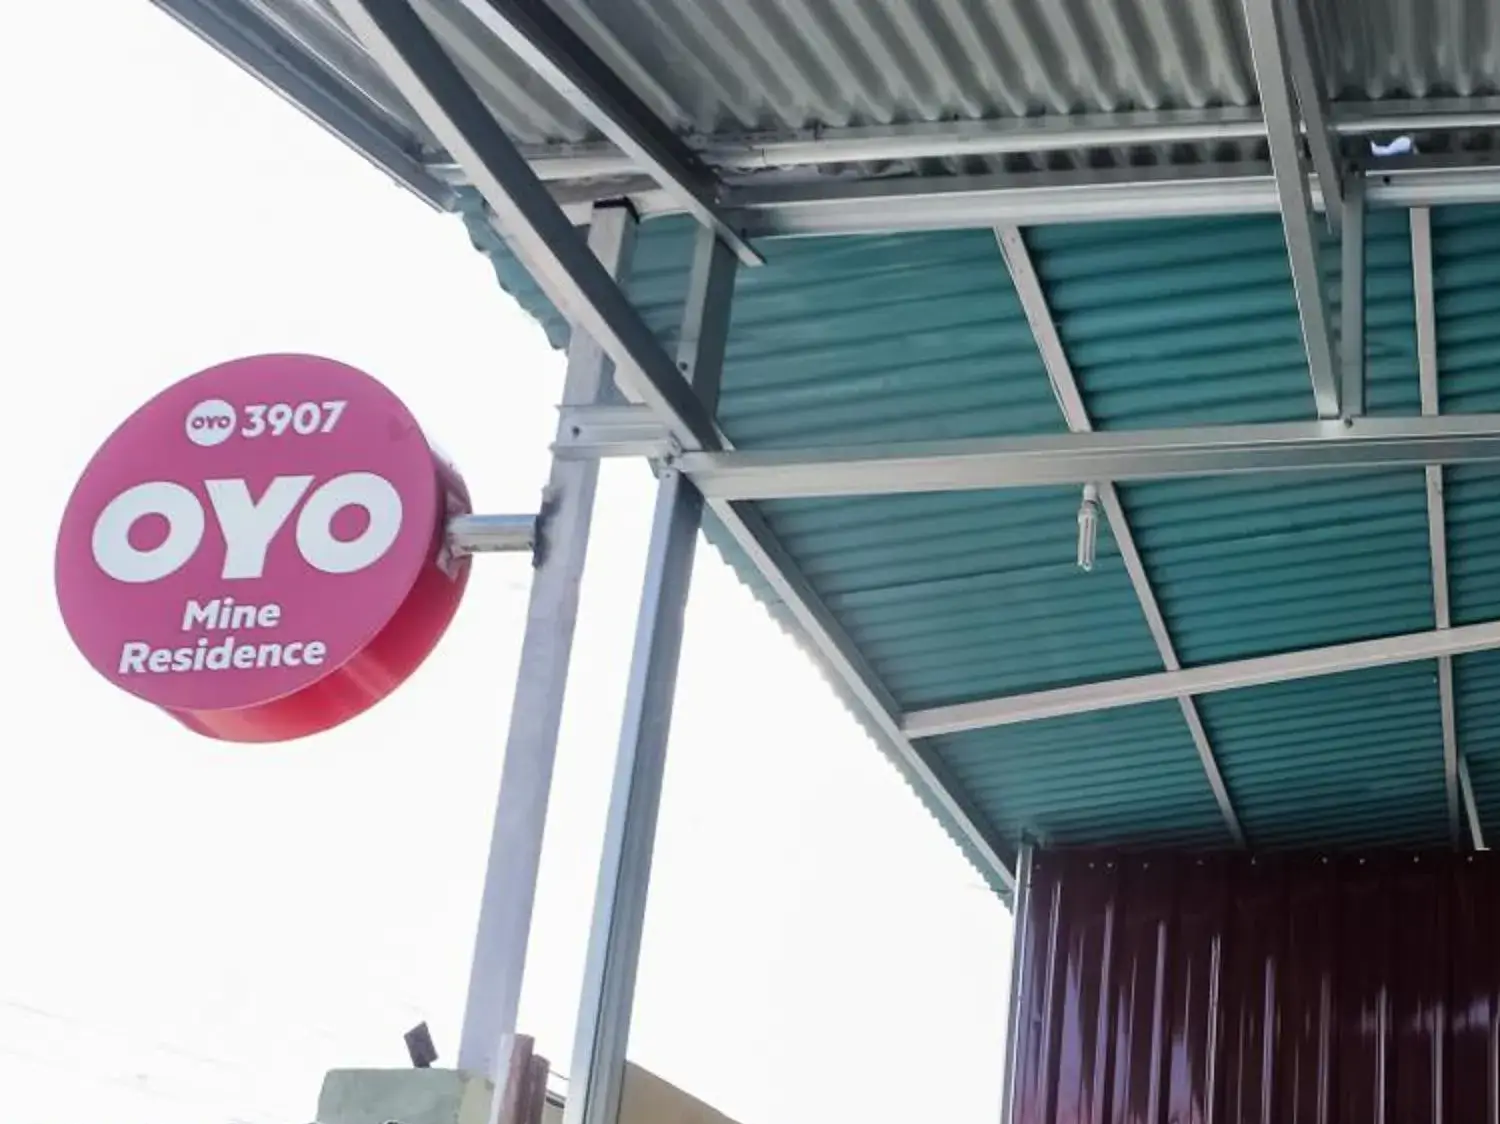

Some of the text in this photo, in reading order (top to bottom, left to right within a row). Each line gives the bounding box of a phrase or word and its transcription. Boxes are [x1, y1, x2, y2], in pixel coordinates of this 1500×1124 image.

[191, 400, 348, 438] OYO 3907
[92, 471, 403, 583] OYO
[182, 597, 281, 631] Mine
[119, 638, 327, 674] Residence
